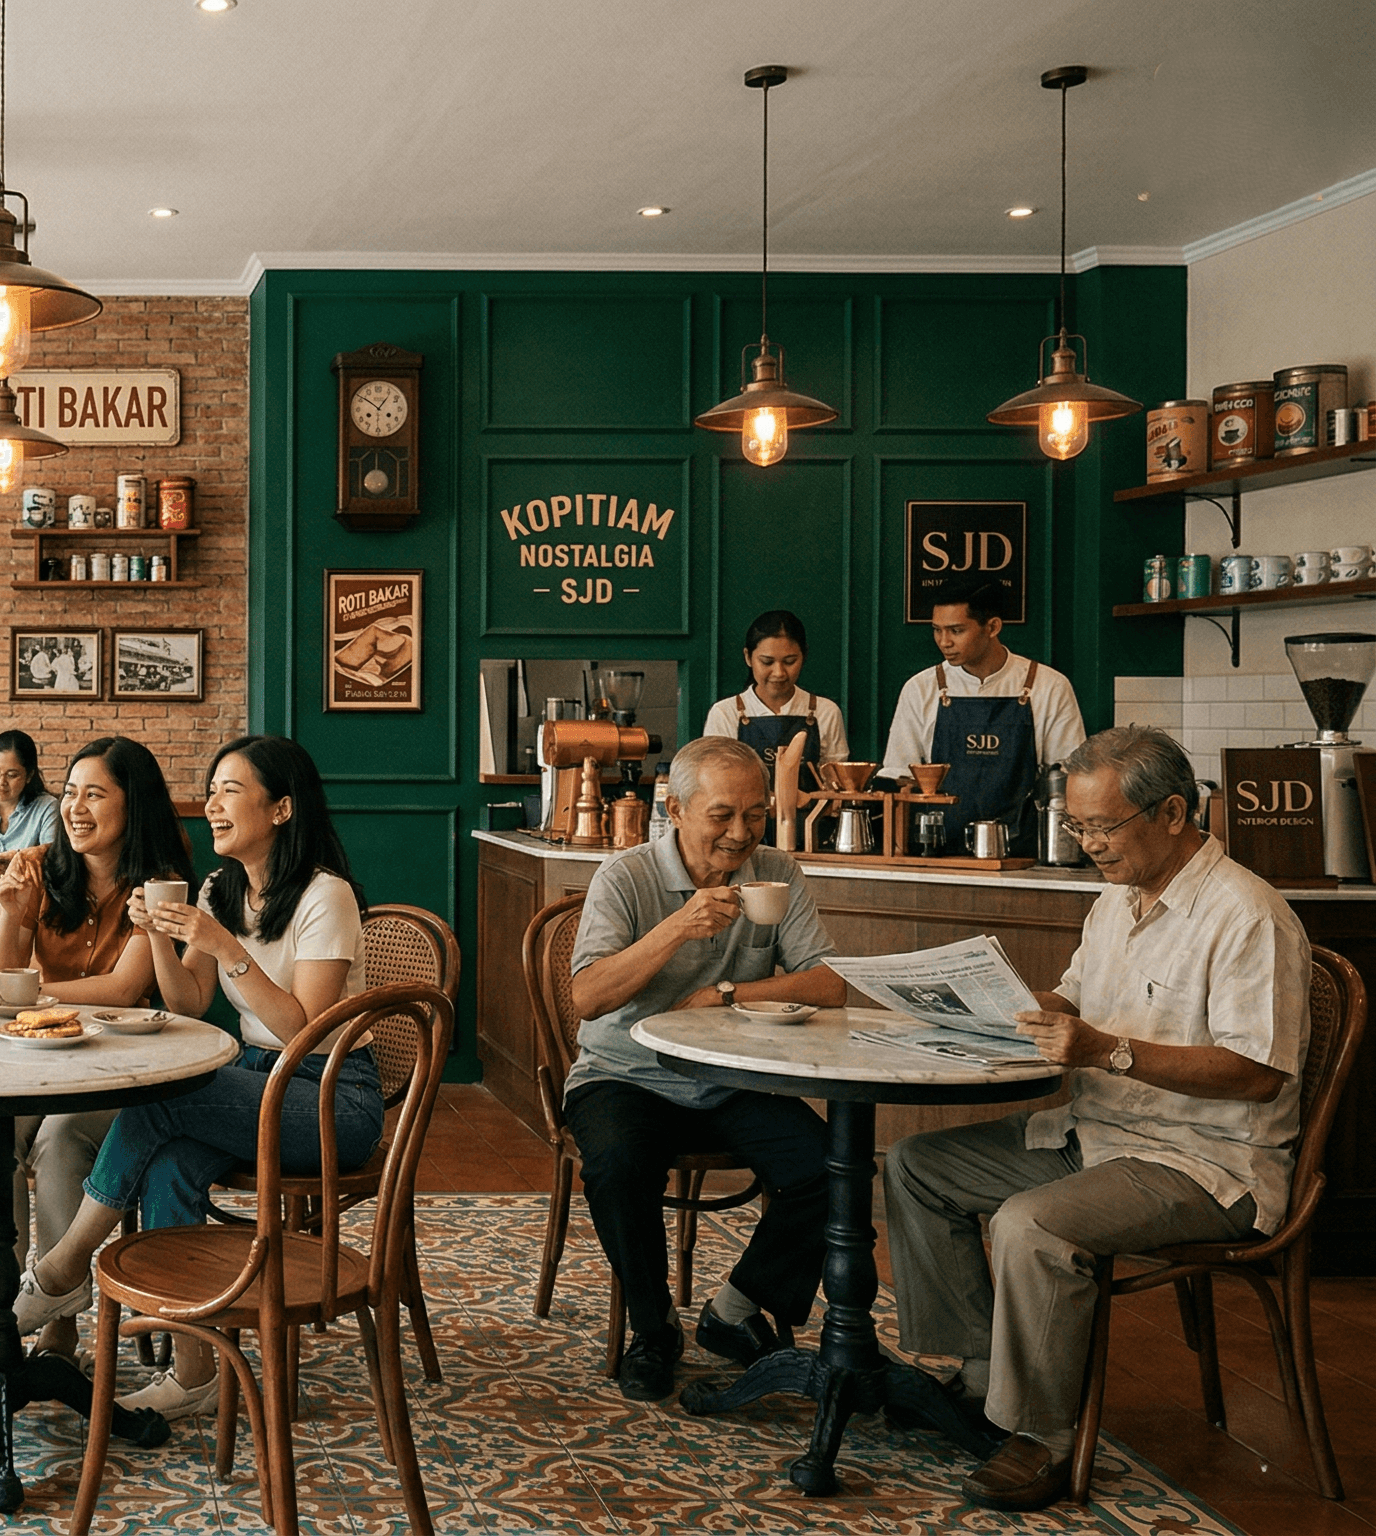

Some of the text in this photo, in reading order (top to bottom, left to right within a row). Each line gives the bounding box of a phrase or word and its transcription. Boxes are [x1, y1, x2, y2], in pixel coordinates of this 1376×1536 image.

[58, 386, 169, 428] BAKAR
[500, 494, 675, 541] KOPITIAM
[520, 544, 655, 568] NOSTALGIA
[922, 531, 1013, 572] SJD
[338, 592, 366, 614] ROTI
[368, 583, 409, 606] BAKAR
[561, 578, 613, 605] SJD
[966, 734, 1000, 749] SJD
[1236, 780, 1314, 812] SJD
